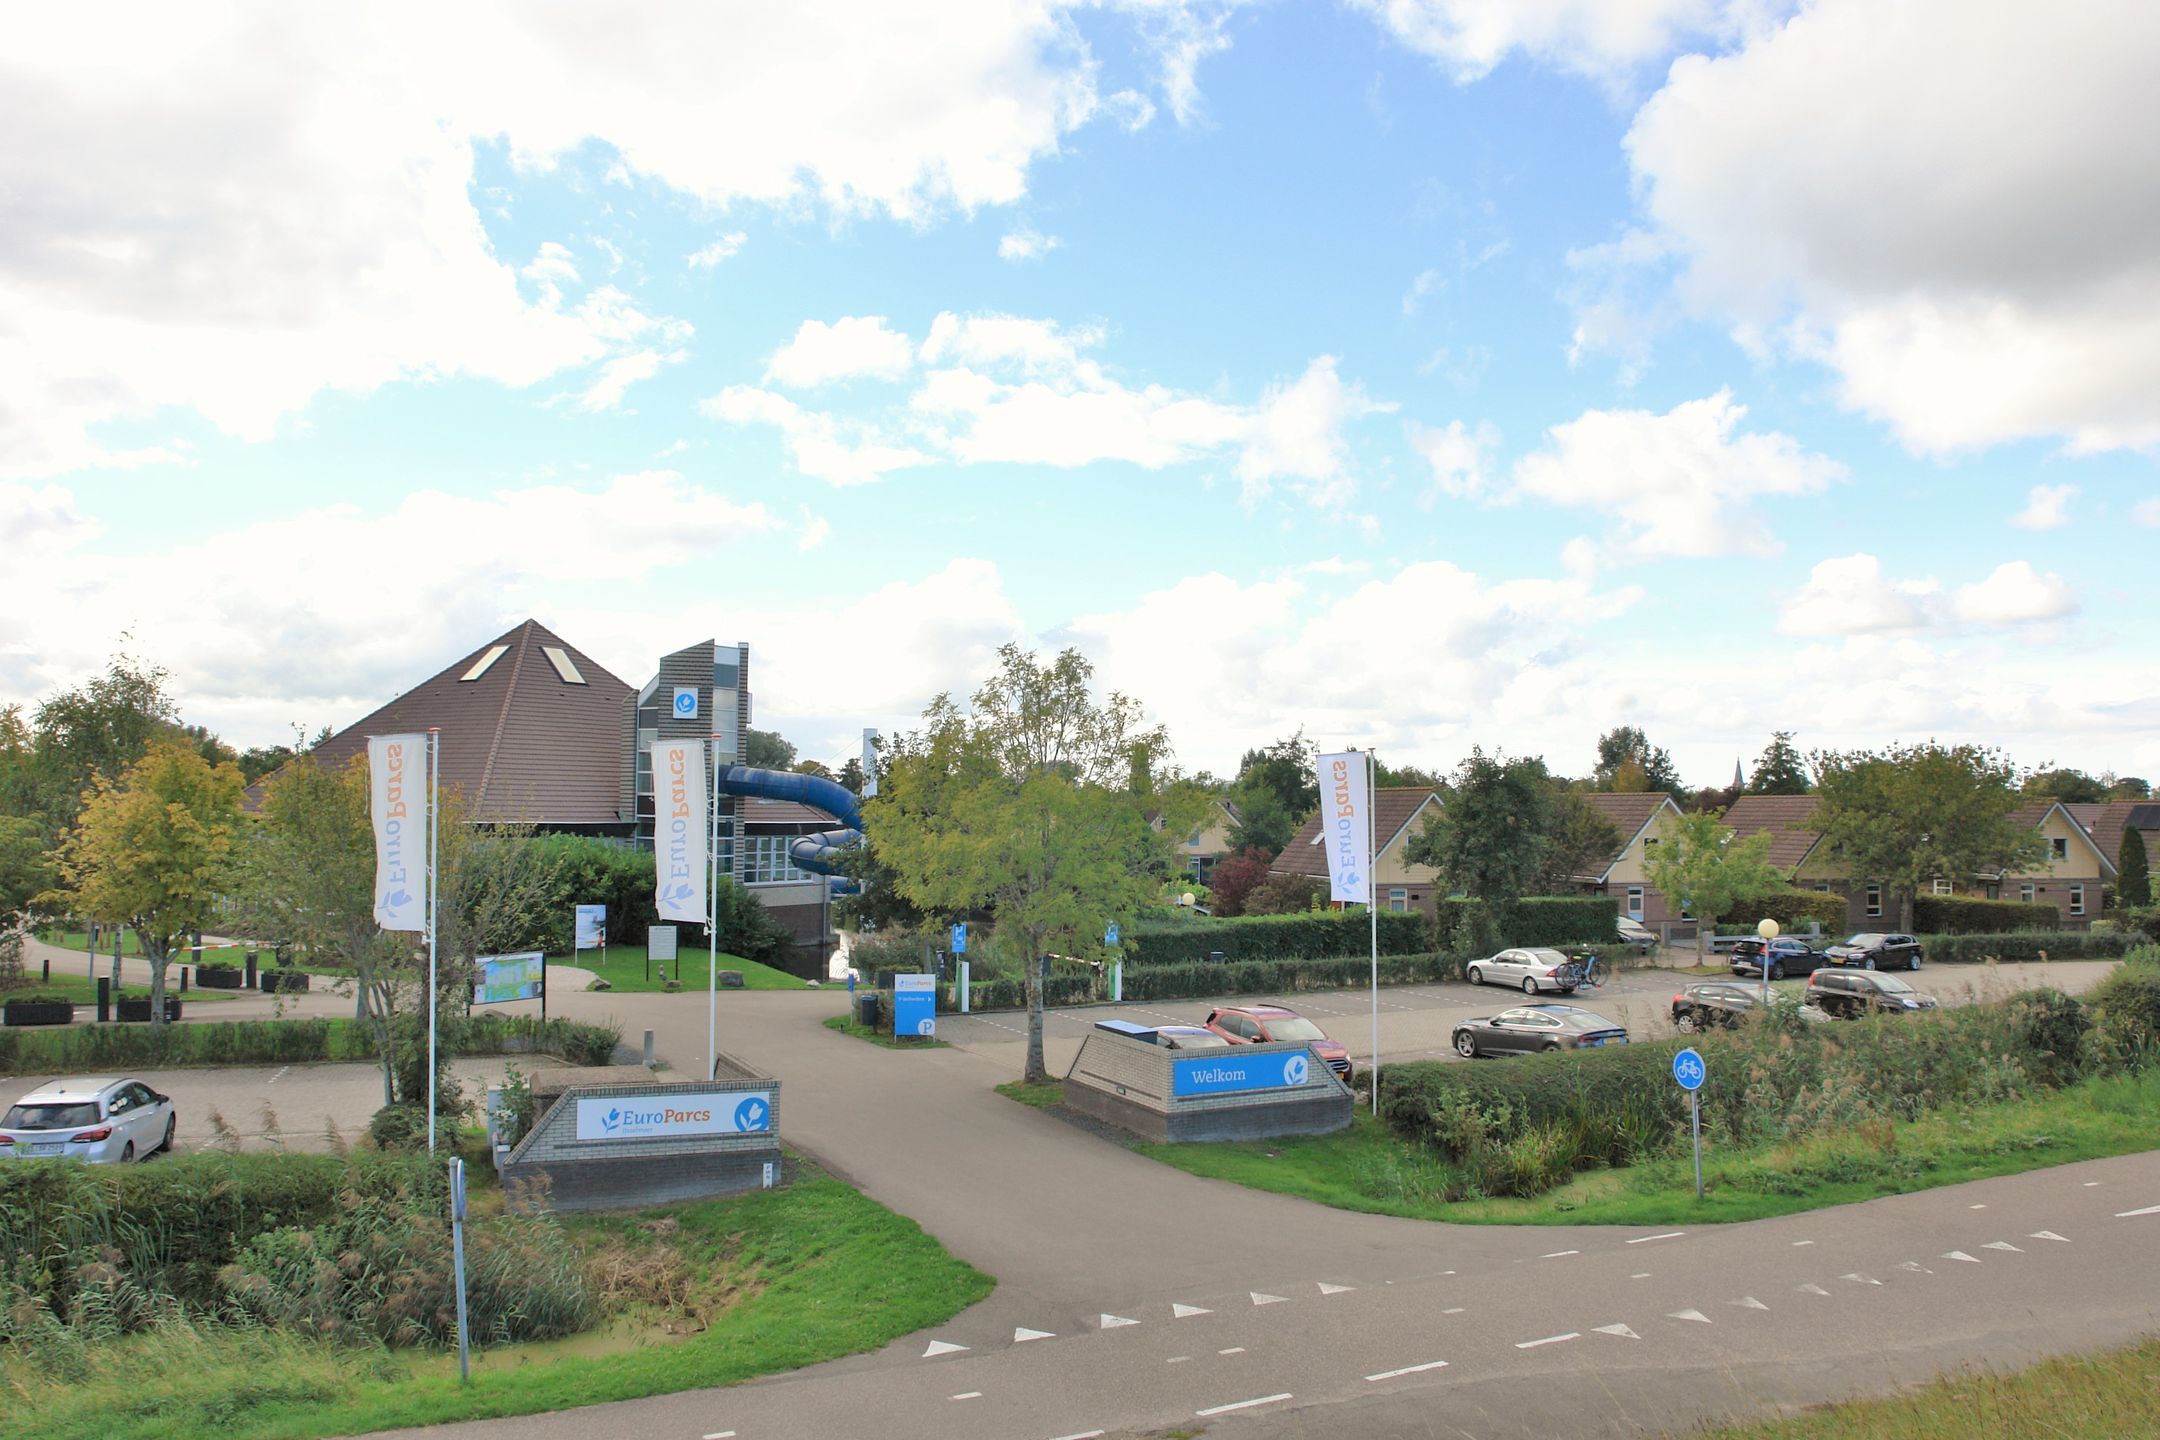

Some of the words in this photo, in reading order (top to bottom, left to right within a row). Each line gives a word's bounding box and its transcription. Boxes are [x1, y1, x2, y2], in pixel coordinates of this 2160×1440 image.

[923, 1021, 932, 1034] P
[1191, 1068, 1246, 1084] Welkom
[622, 1108, 711, 1126] EuroParcs
